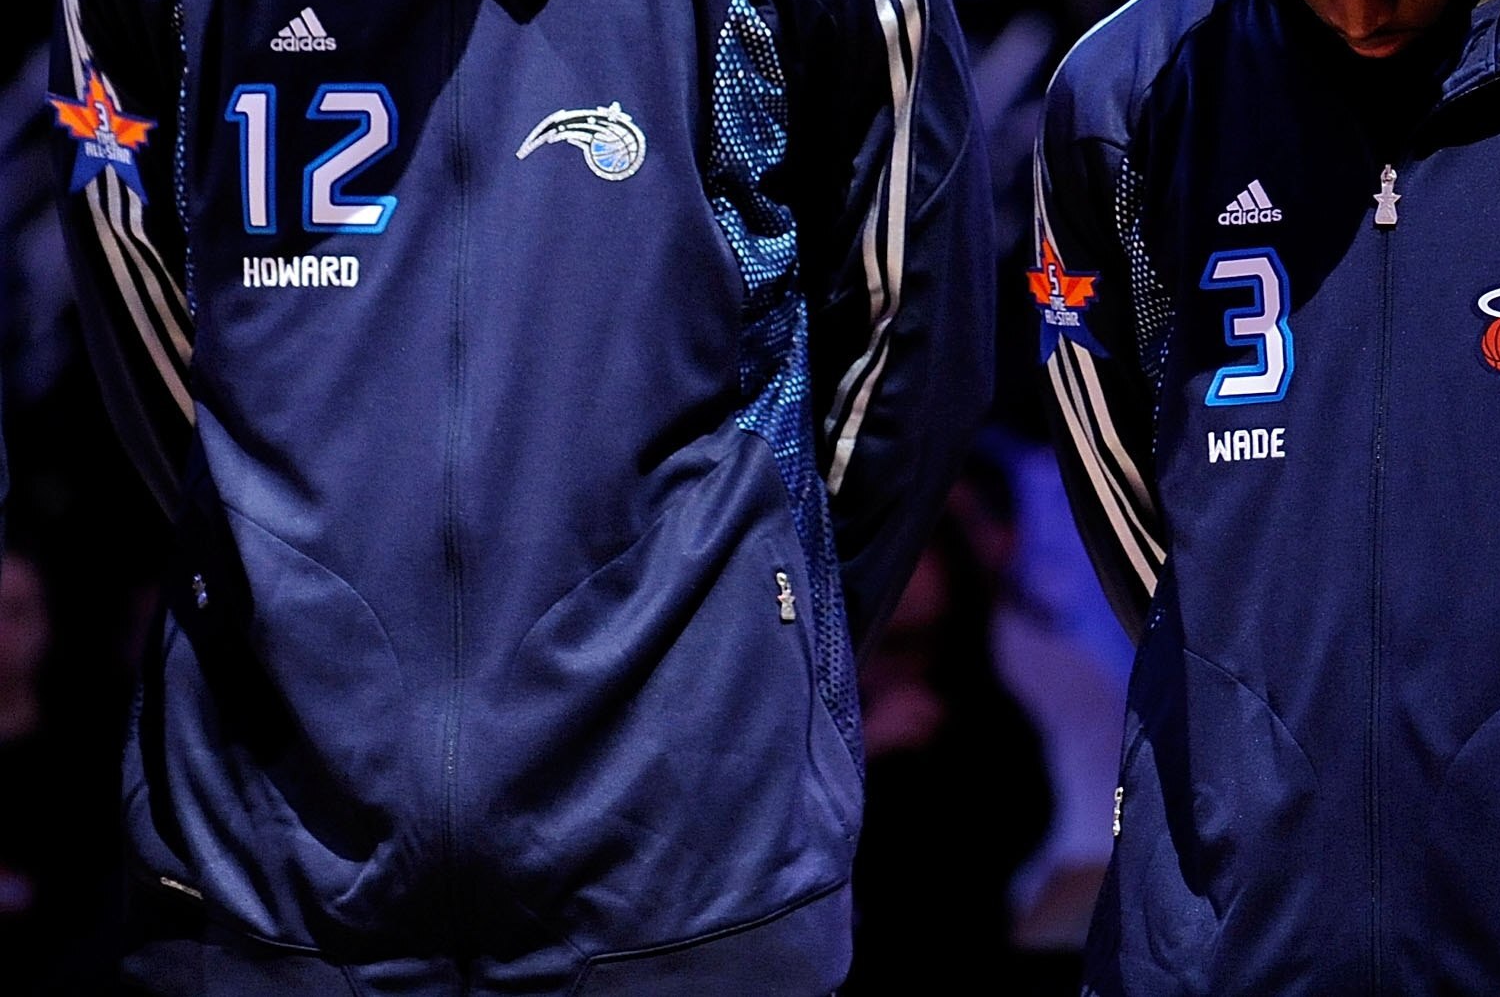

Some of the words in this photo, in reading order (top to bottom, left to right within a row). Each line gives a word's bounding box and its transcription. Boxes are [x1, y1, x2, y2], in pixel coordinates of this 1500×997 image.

[270, 35, 337, 52] adidas
[94, 102, 109, 131] 3
[224, 83, 399, 235] 12
[1218, 207, 1282, 226] adidas
[243, 256, 359, 288] HOWARD
[1048, 265, 1059, 295] 5
[1199, 247, 1295, 406] 3
[1207, 427, 1286, 464] WADE
